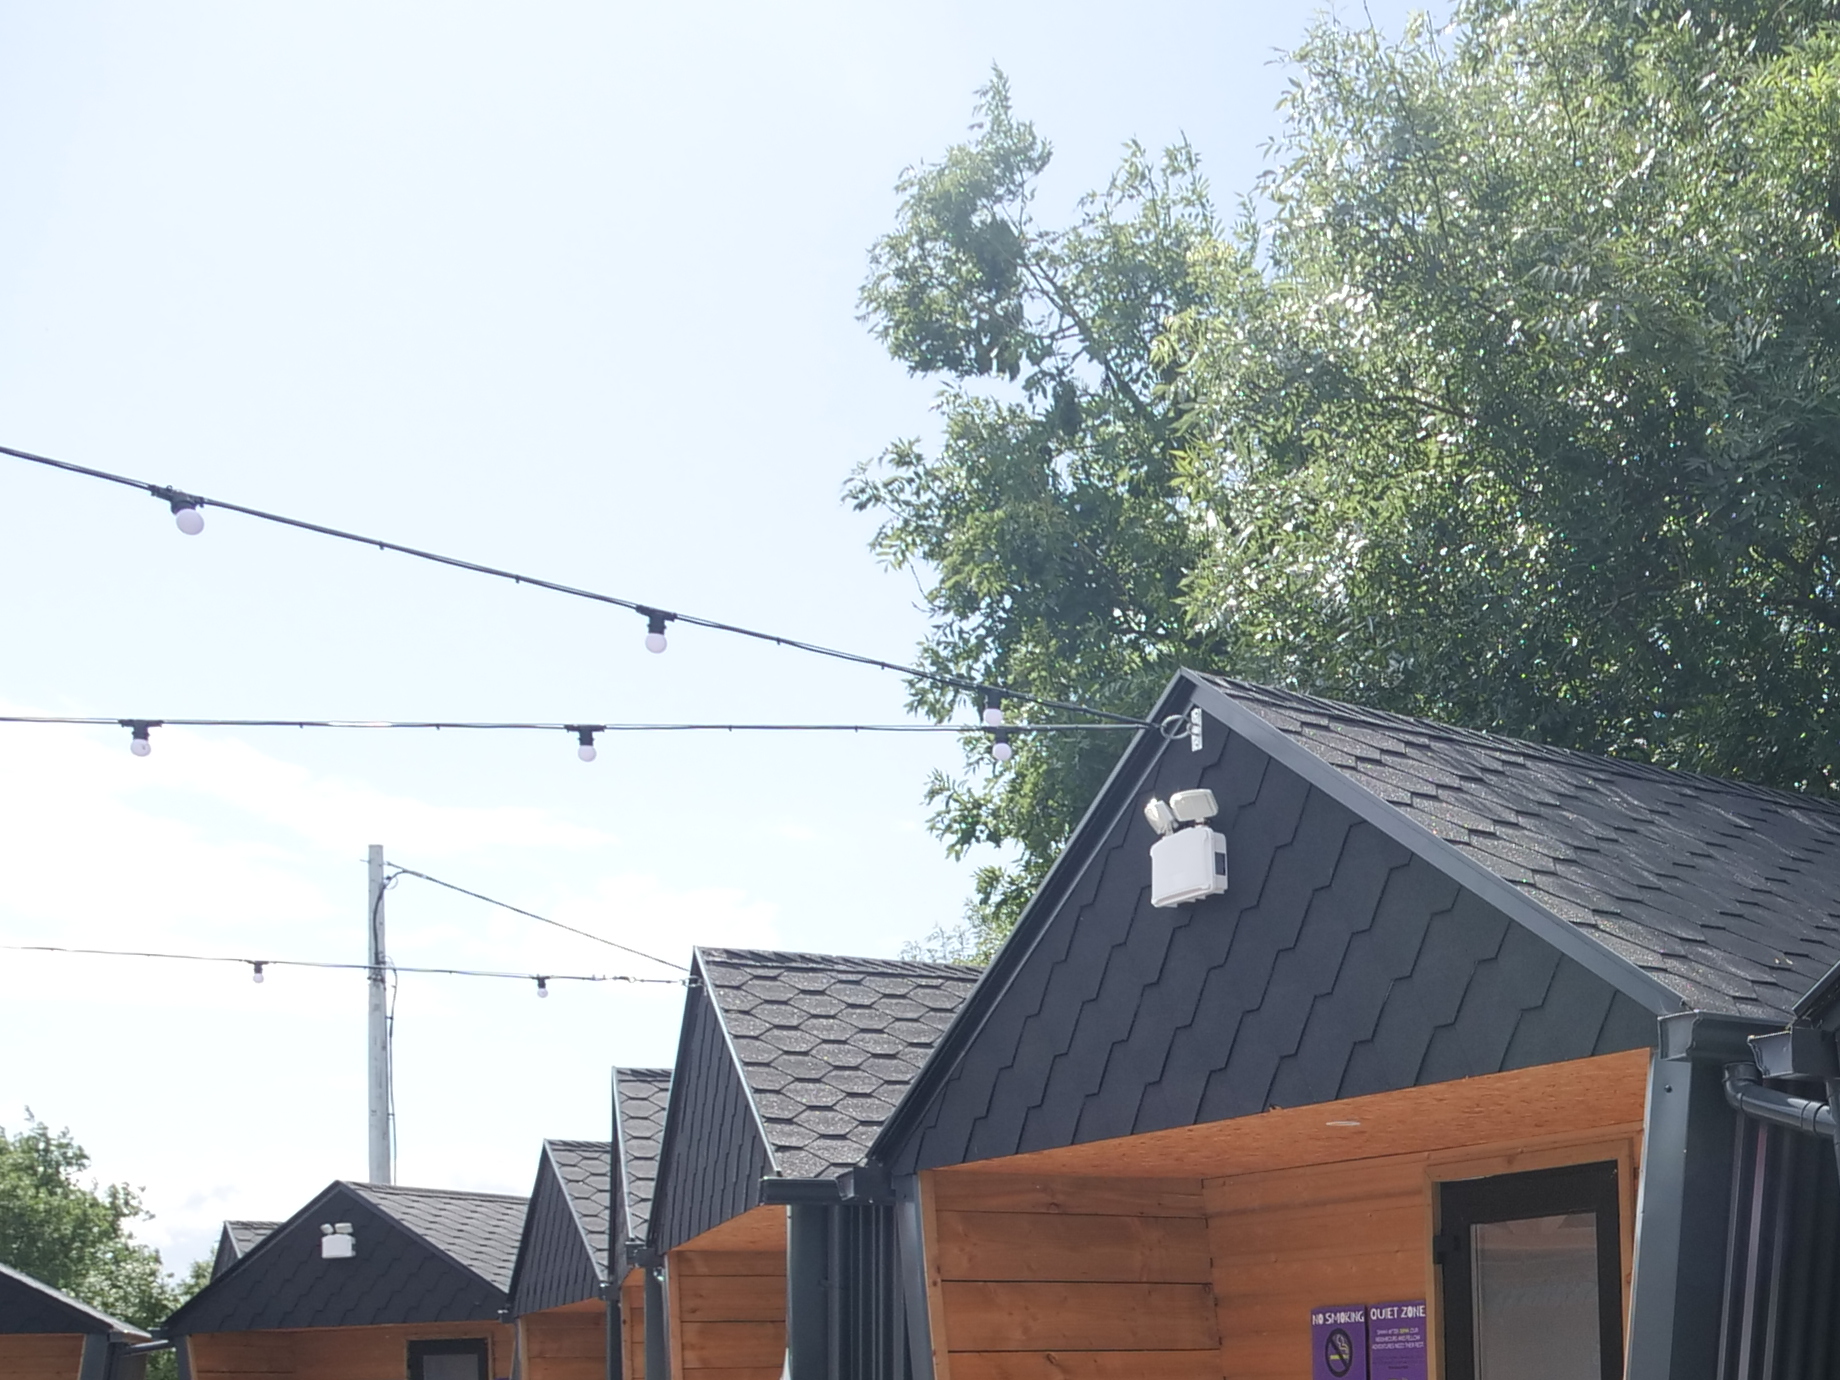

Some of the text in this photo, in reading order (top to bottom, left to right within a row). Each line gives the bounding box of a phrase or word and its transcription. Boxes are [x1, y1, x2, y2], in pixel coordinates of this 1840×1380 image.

[1312, 1311, 1365, 1326] NO SMOKING
[1370, 1305, 1426, 1320] QUIET ZONE
